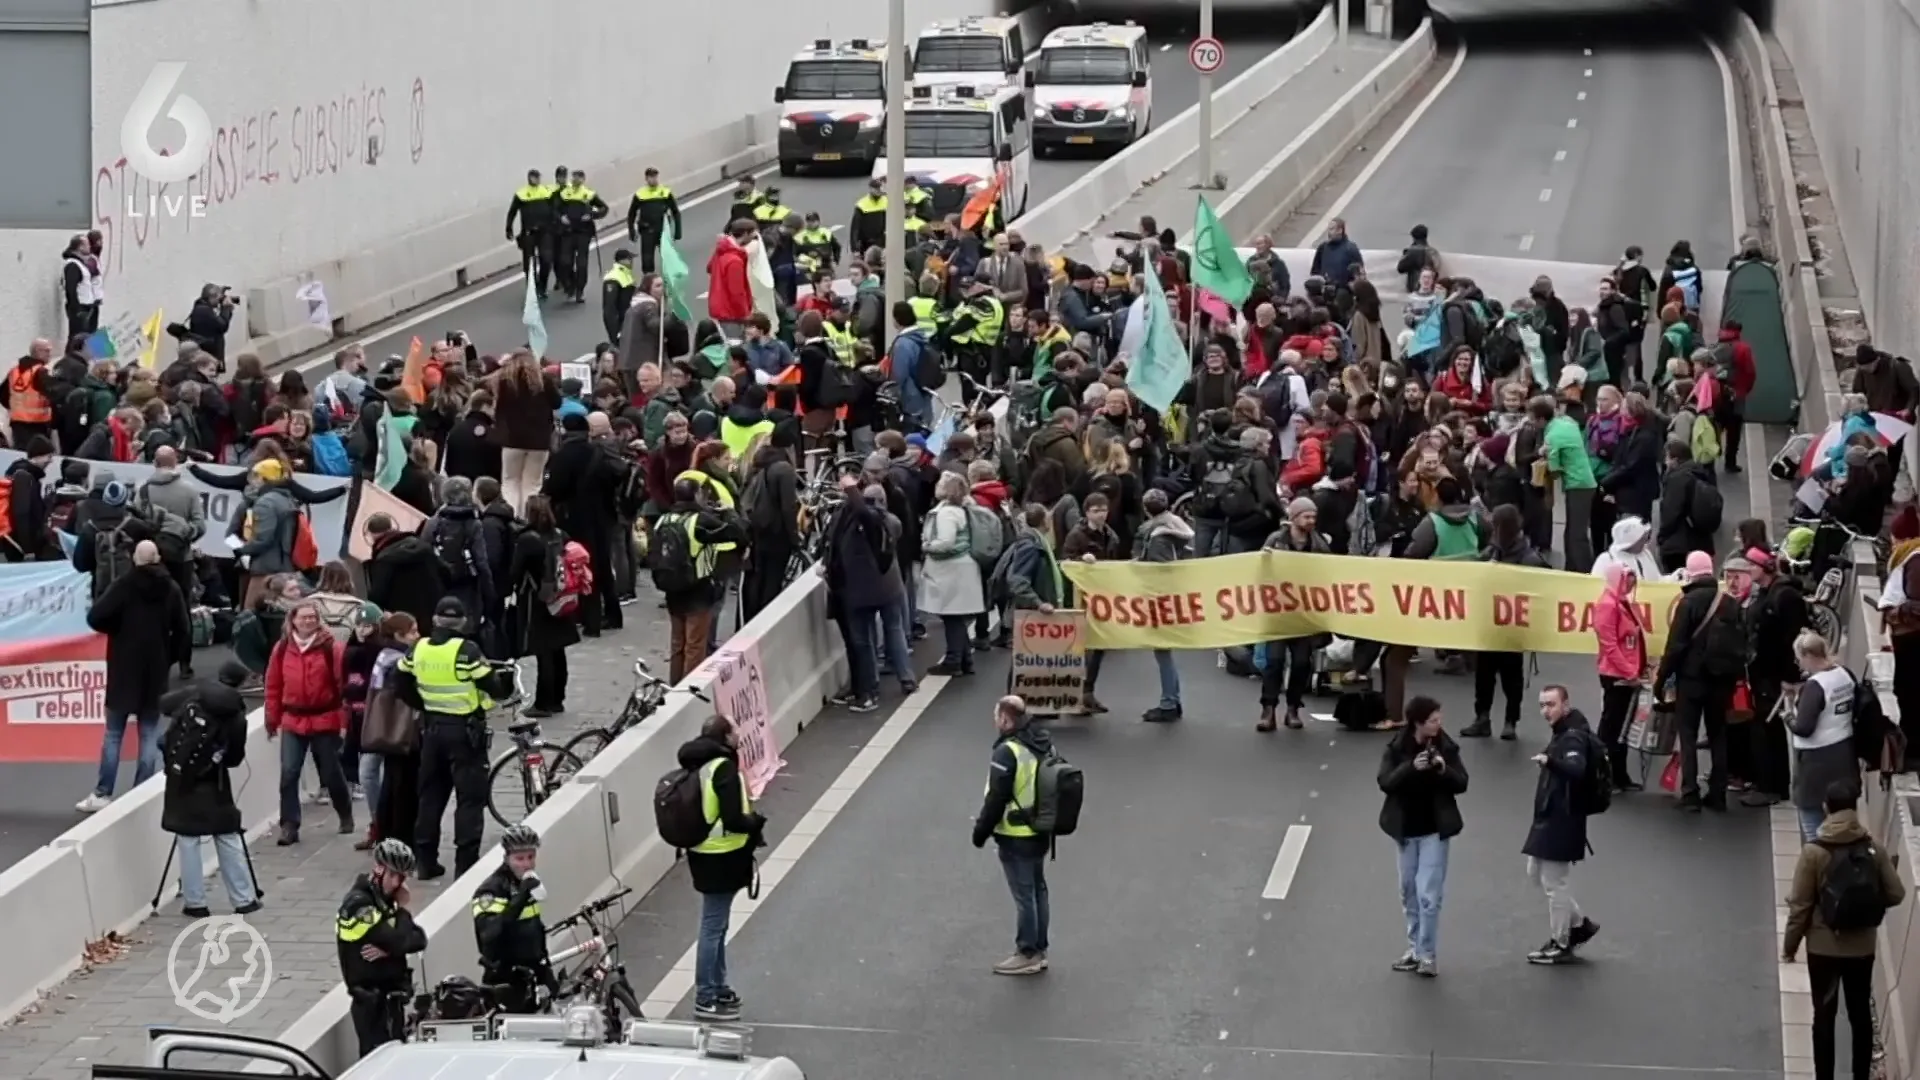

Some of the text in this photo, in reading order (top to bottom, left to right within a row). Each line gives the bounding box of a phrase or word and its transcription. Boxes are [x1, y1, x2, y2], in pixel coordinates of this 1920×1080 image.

[1197, 49, 1218, 62] 70
[290, 81, 386, 184] SUBSIDIES
[1216, 581, 1375, 621] SUBSIDIES
[1392, 584, 1466, 621] VAN
[1493, 594, 1530, 628] DE
[1557, 601, 1653, 634] BAN
[1025, 622, 1075, 639] STOP
[1015, 653, 1082, 667] Subsidie
[0, 664, 105, 690] extinction
[36, 684, 107, 719] rebelli
